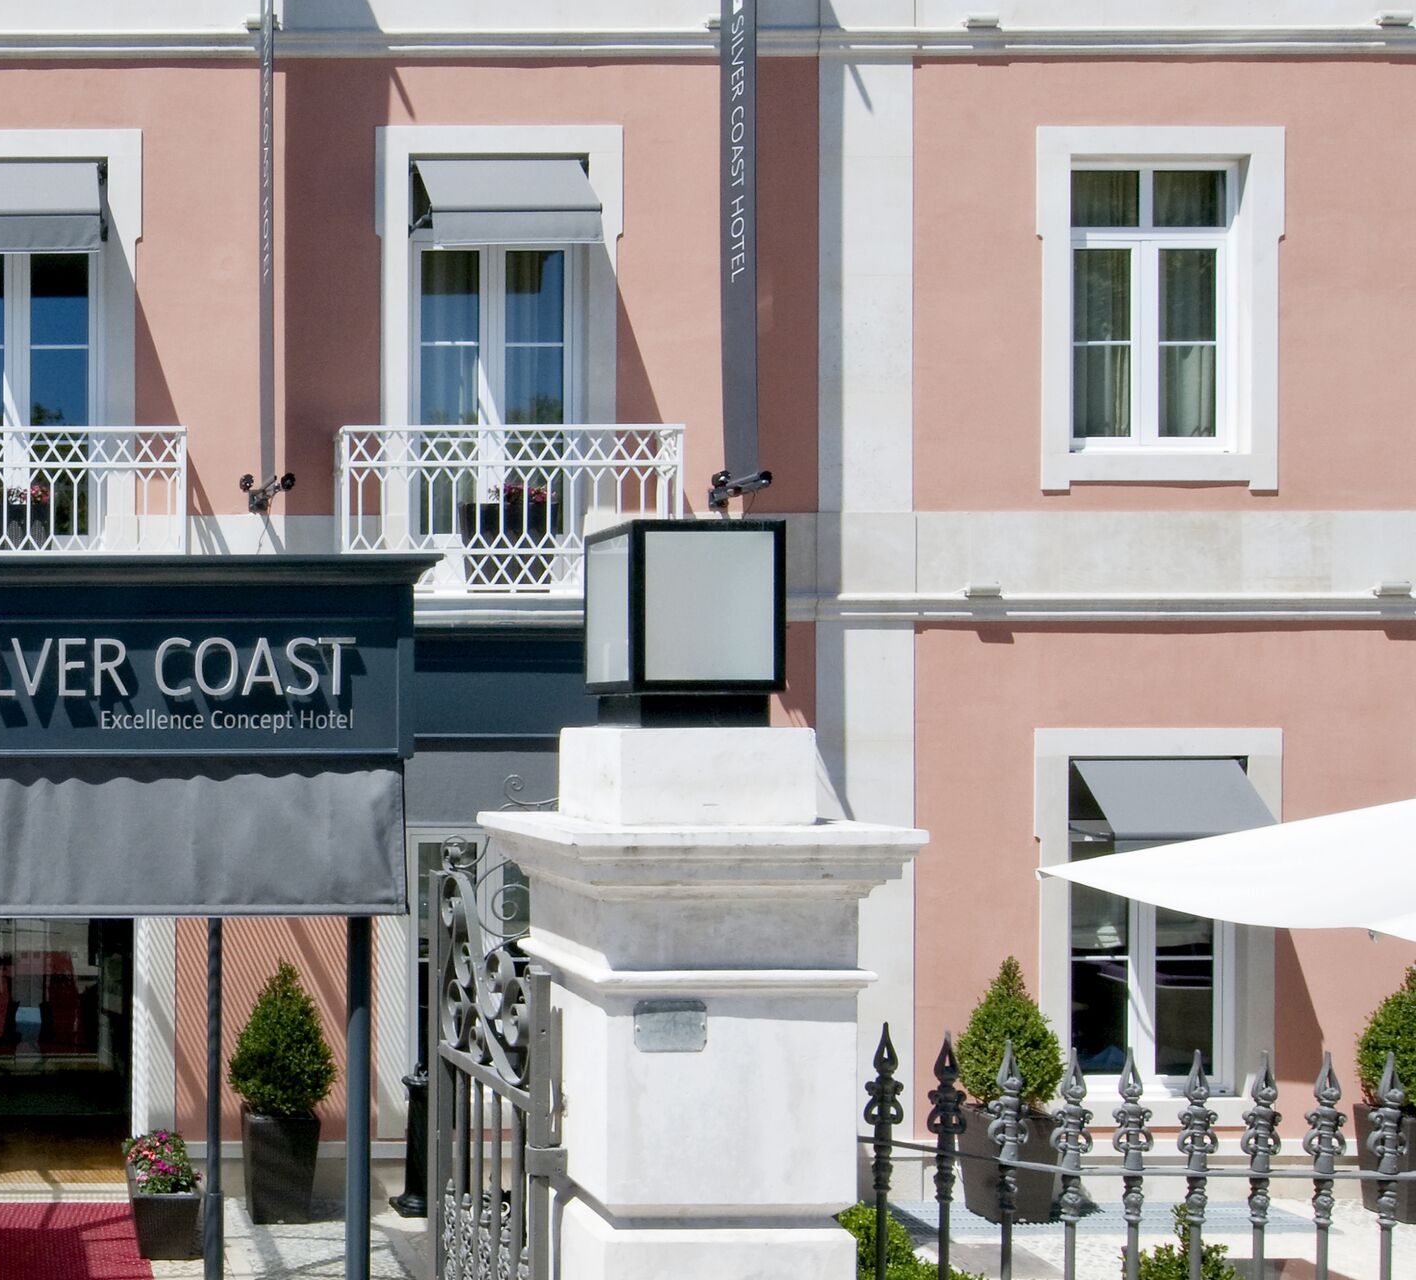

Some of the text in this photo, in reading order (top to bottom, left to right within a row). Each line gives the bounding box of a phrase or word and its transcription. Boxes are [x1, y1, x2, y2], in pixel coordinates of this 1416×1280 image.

[731, 14, 745, 101] SILVER
[731, 106, 745, 186] COAST
[731, 195, 745, 283] HOTEL
[154, 637, 356, 696] COAST
[100, 709, 354, 735] Excellence Concept Hotel
